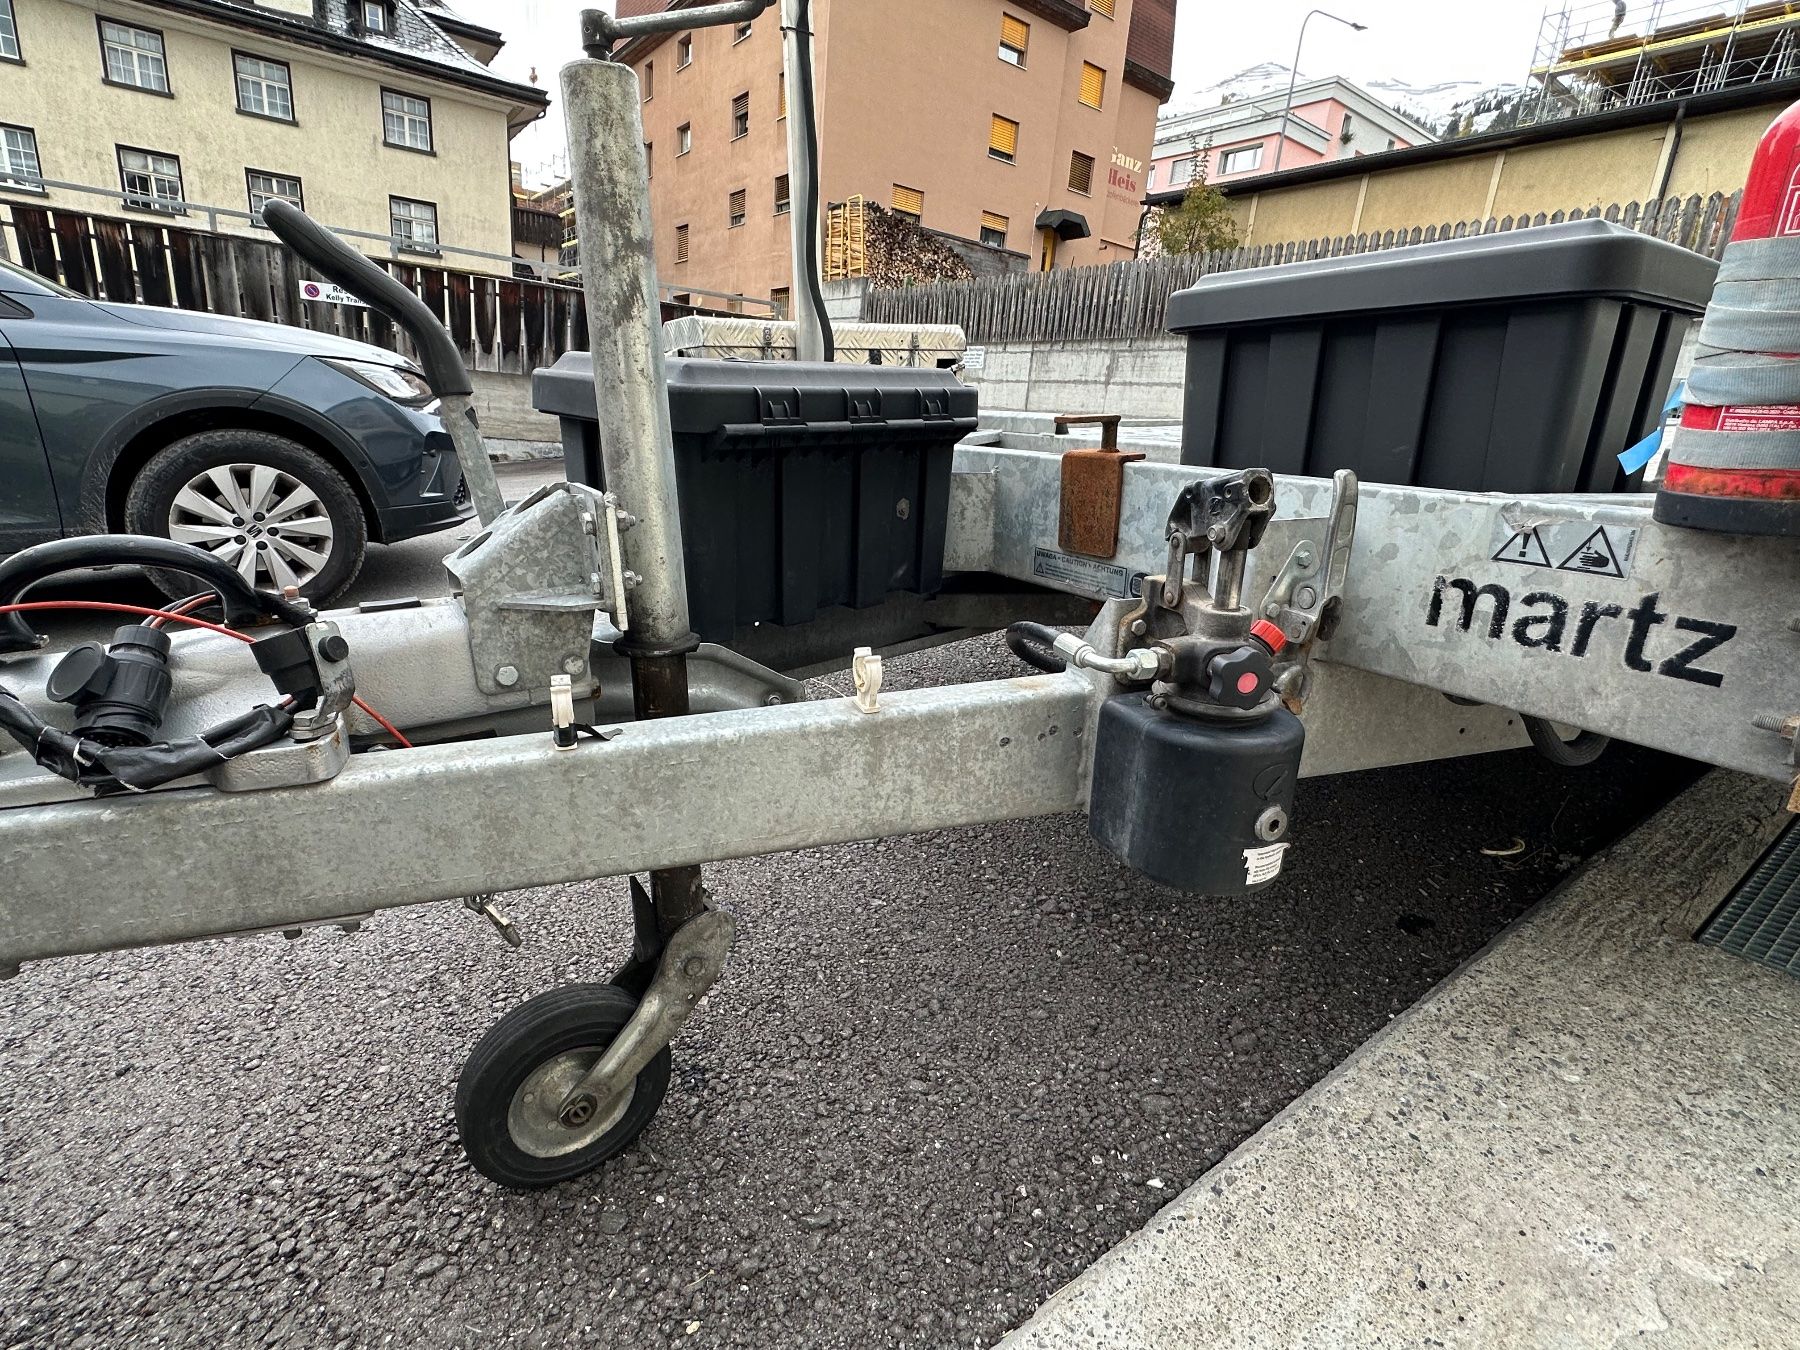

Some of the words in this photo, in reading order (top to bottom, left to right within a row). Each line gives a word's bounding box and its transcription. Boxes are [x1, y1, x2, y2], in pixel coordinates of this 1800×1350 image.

[326, 293, 344, 302] Kelly
[1036, 550, 1056, 560] UWAGA
[1061, 556, 1088, 568] CAUTION
[1426, 574, 1737, 688] martz
